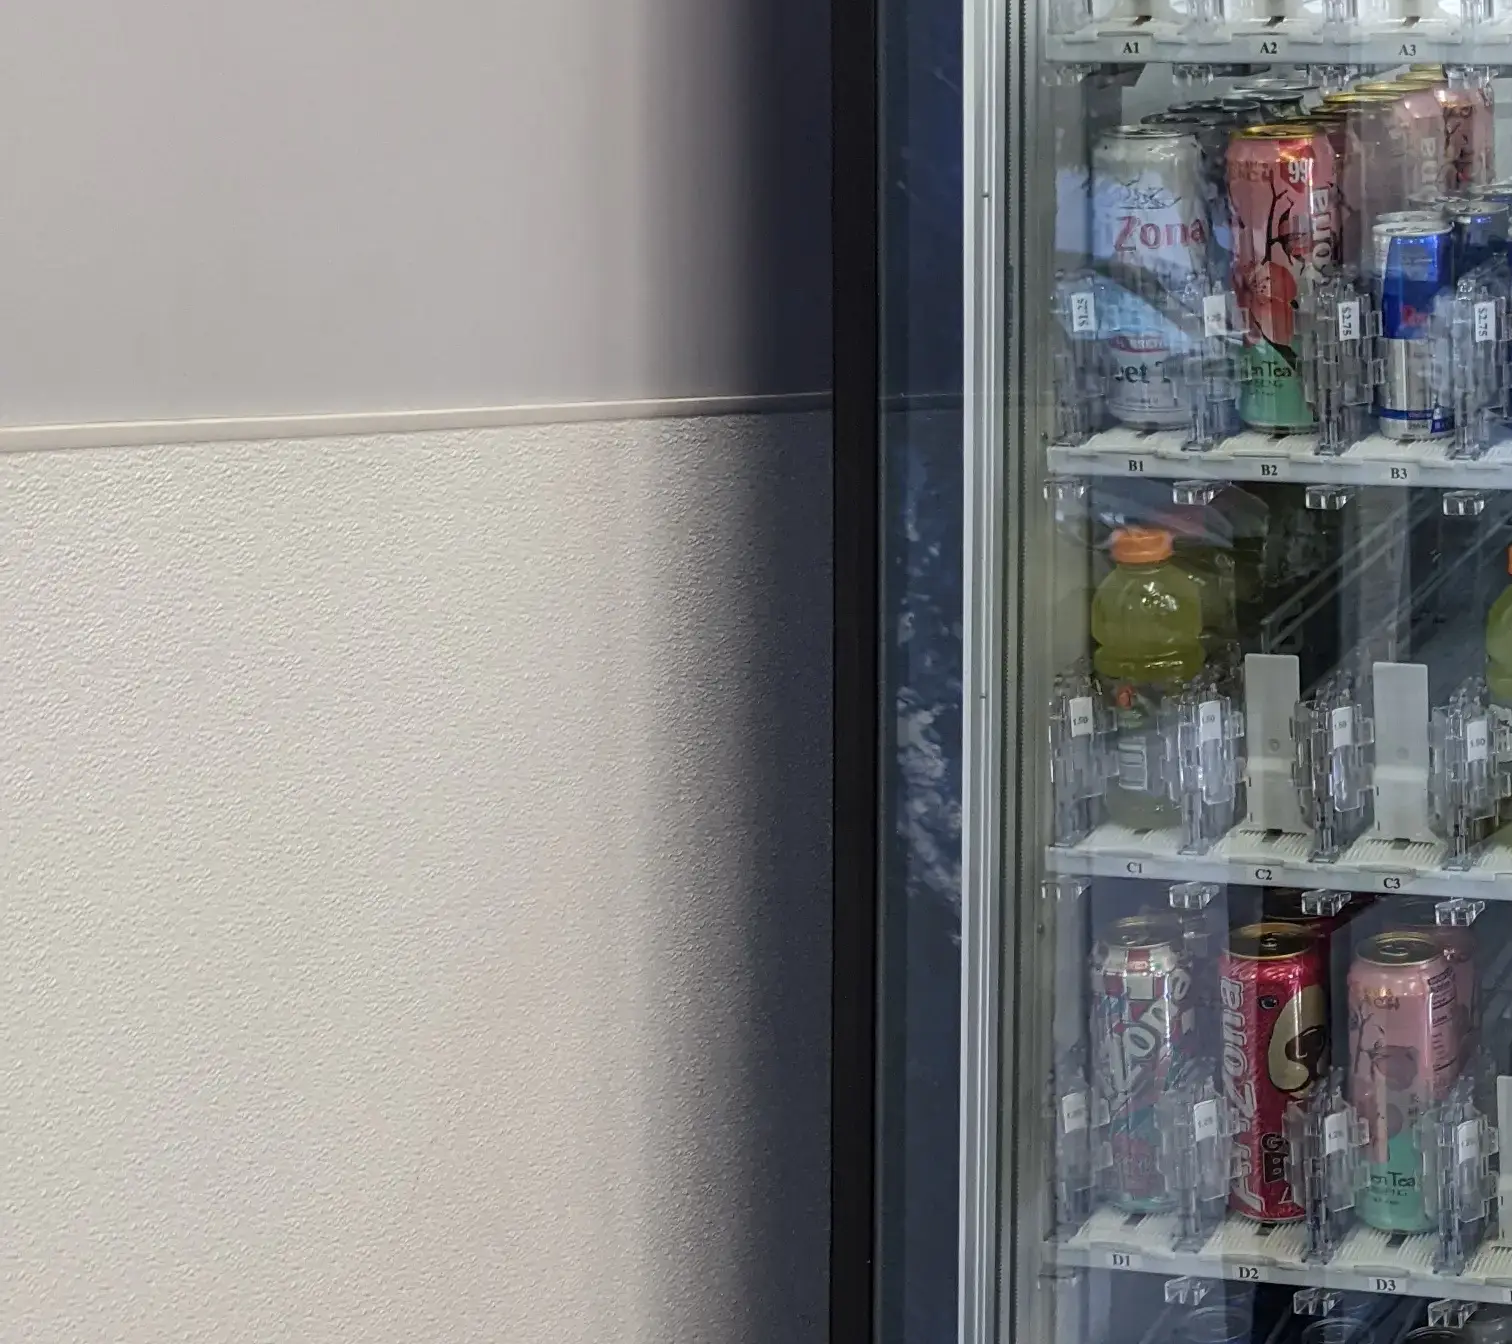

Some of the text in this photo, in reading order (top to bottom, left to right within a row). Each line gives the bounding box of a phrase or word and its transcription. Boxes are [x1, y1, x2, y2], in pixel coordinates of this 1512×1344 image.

[1122, 42, 1139, 55] A1
[1260, 42, 1277, 55] A2
[1400, 43, 1417, 57] A3
[1342, 306, 1352, 336] $2.75
[1477, 306, 1488, 337] $2.75
[1265, 360, 1293, 379] Tea
[1128, 459, 1144, 472] B1
[1261, 464, 1278, 477] B2
[1390, 467, 1408, 480] B3
[1073, 716, 1089, 726] 1.50
[1126, 862, 1143, 874] C1
[1255, 868, 1273, 881] C2
[1383, 877, 1401, 890] C3
[1387, 1171, 1416, 1188] Tea
[1112, 1254, 1131, 1267] D1
[1238, 1266, 1258, 1280] D2
[1375, 1278, 1396, 1292] D3
